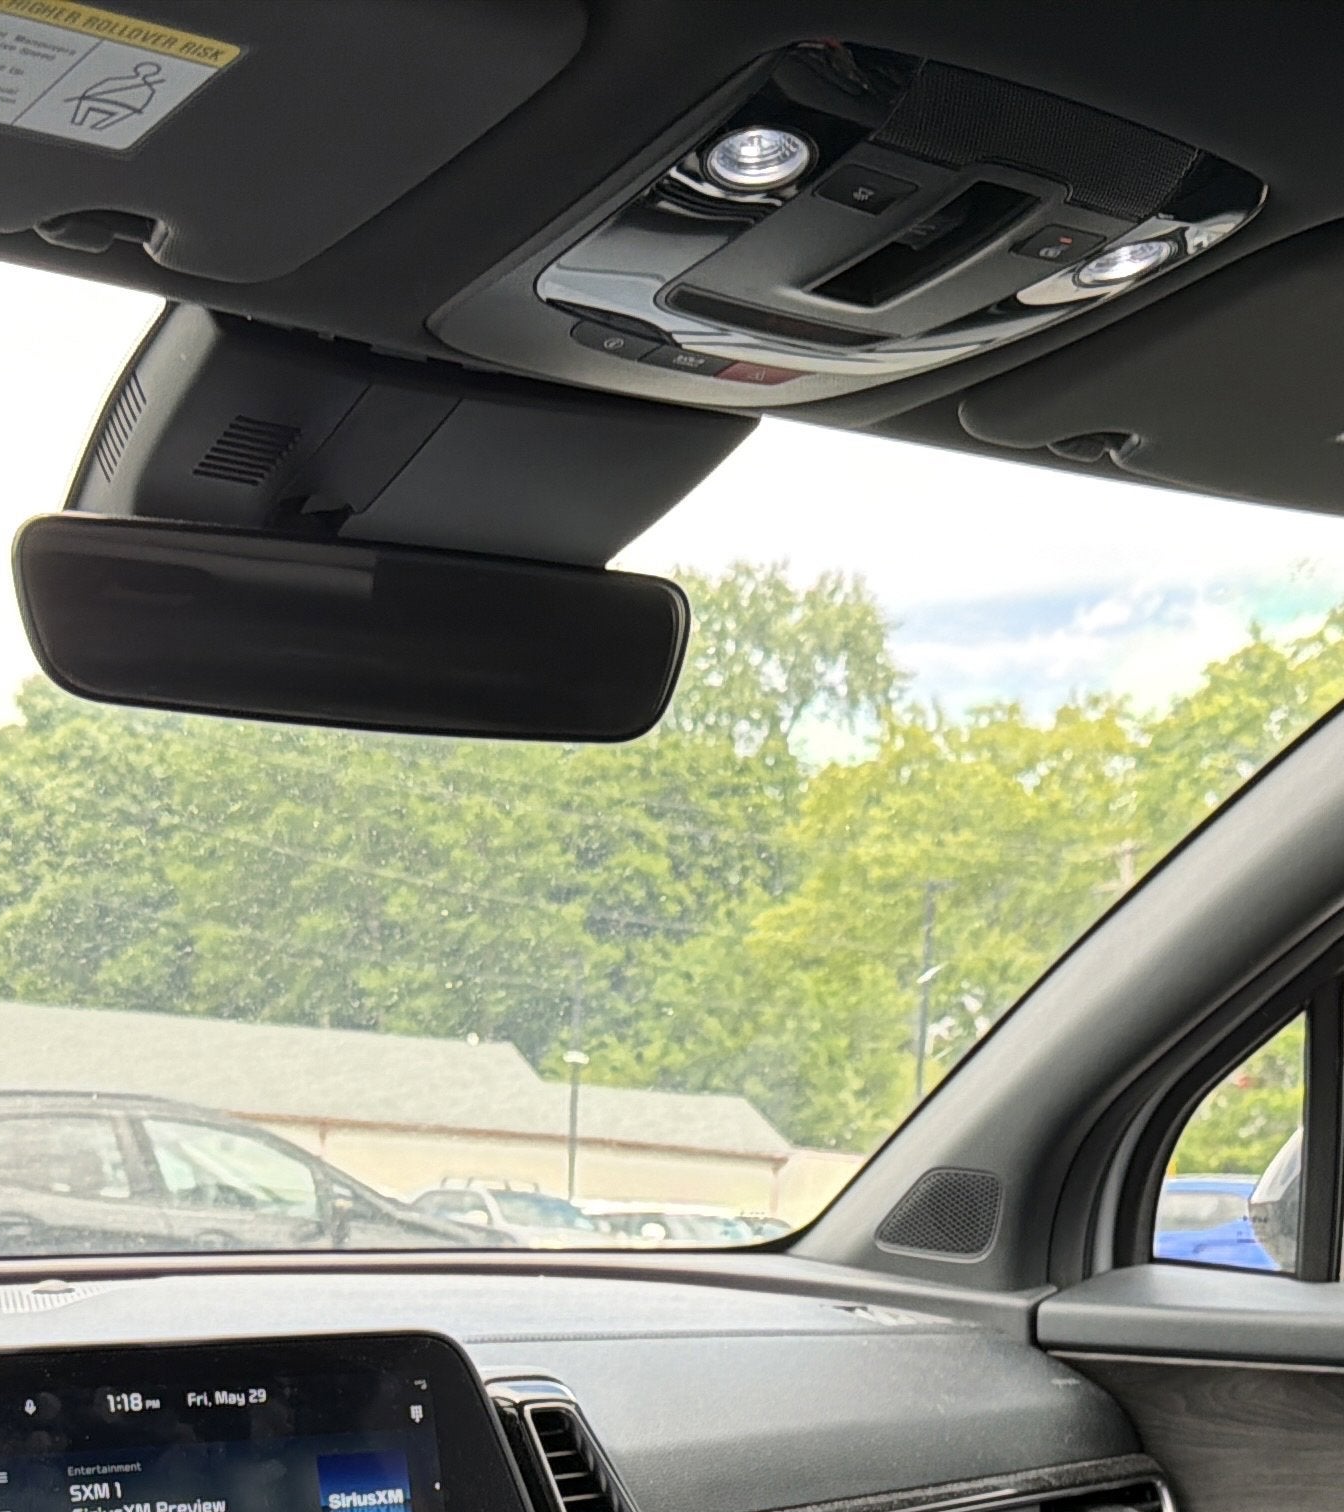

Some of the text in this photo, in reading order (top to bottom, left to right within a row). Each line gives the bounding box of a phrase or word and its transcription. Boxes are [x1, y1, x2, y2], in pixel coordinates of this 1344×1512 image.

[82, 16, 176, 47] ROLLOVER
[179, 42, 226, 61] RISK
[107, 1393, 142, 1413] 1:18
[187, 1388, 267, 1408] Fri, May 29
[67, 1462, 142, 1477] Entertainment
[69, 1483, 110, 1503] SXM
[328, 1488, 404, 1510] SiriusXM
